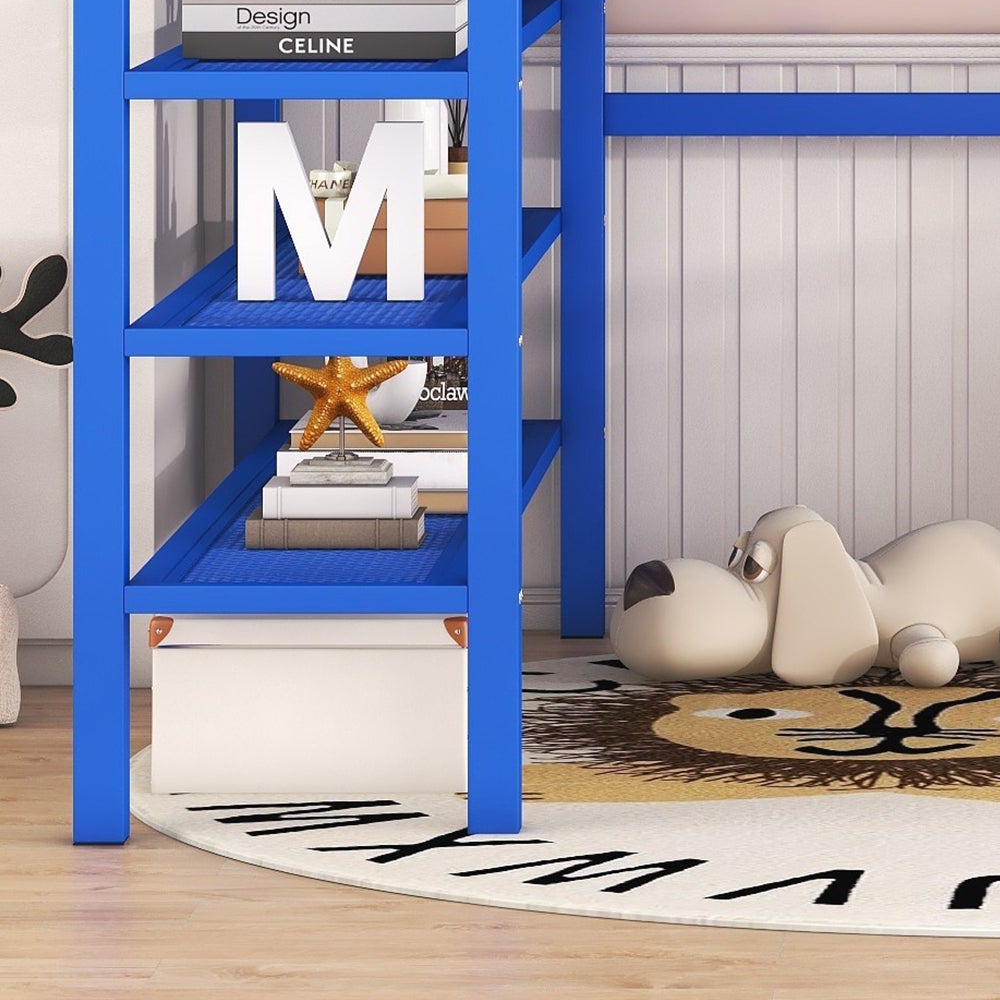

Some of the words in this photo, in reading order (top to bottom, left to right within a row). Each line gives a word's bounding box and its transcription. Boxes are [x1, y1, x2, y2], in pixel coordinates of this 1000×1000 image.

[237, 7, 311, 30] Design
[278, 37, 355, 54] CELINE
[237, 121, 424, 301] M
